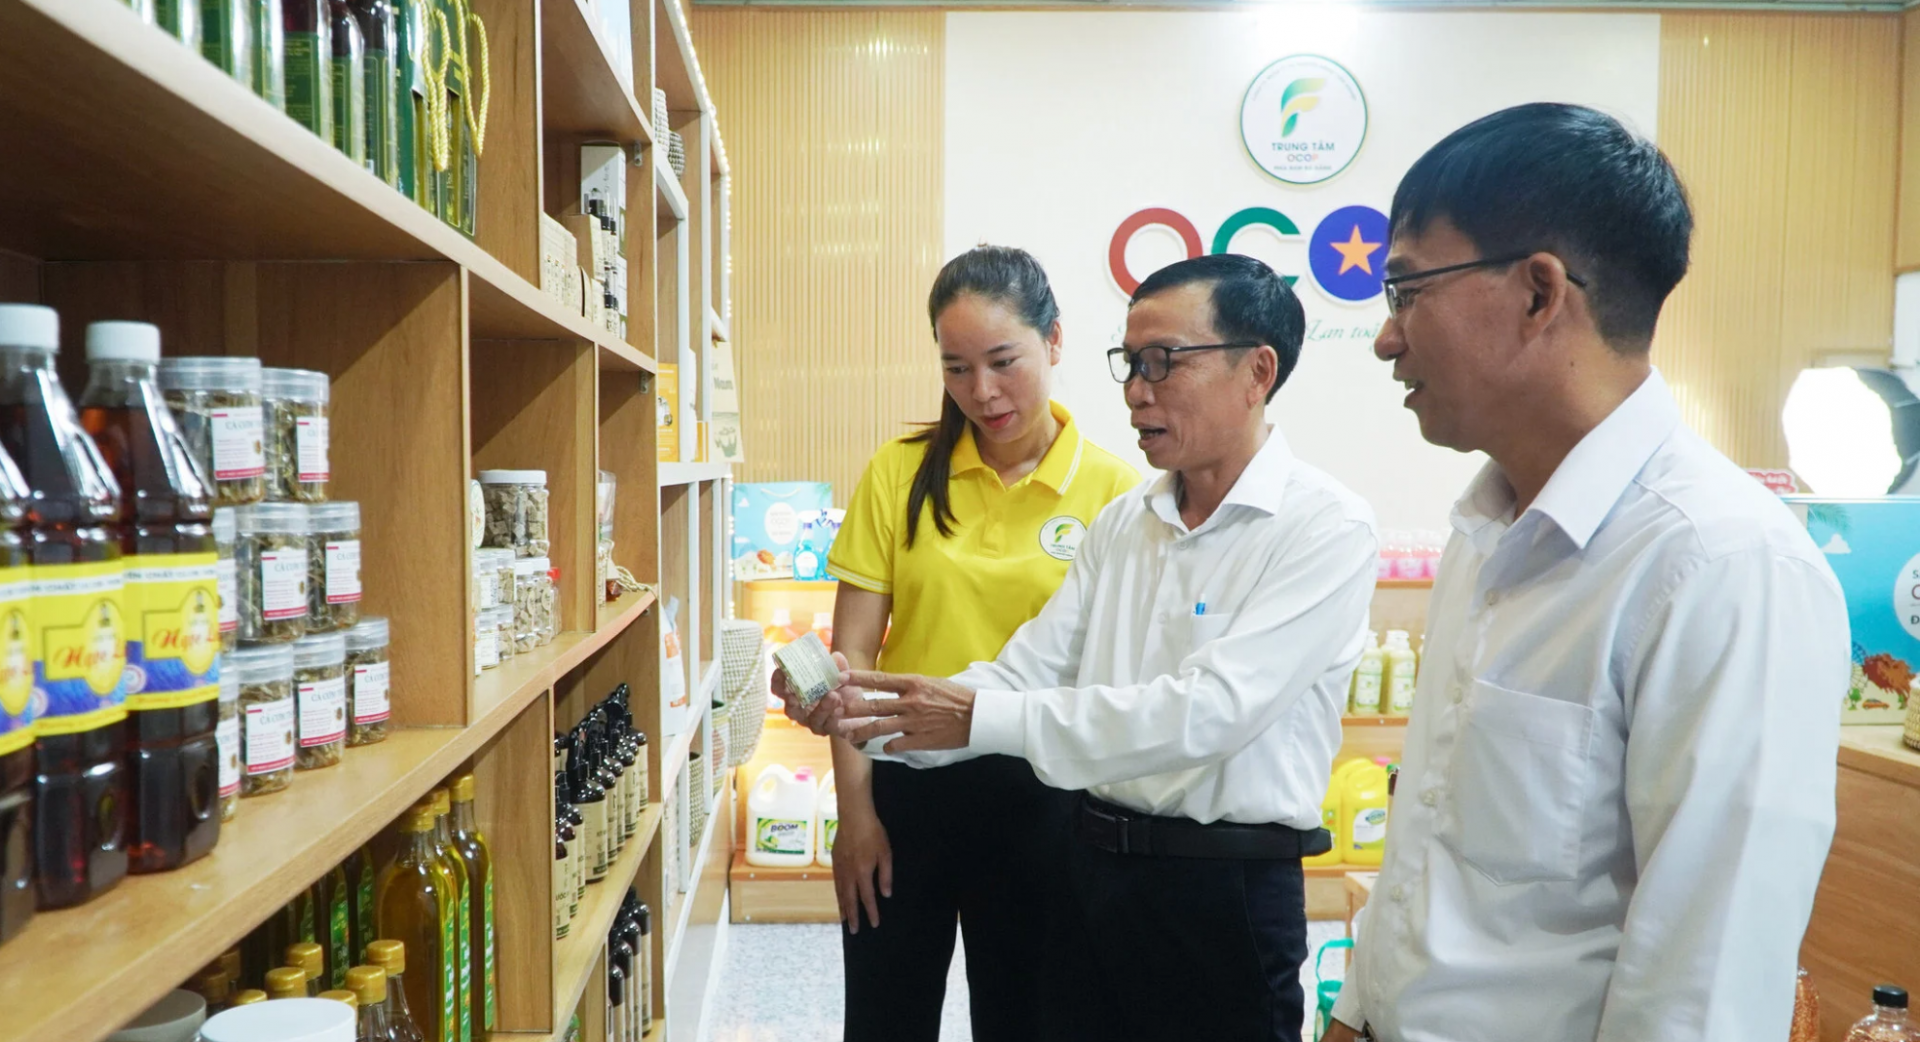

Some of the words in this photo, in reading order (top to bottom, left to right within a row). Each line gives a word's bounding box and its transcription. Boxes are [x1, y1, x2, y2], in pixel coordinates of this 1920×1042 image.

[1271, 142, 1308, 151] TRUNG
[1312, 139, 1335, 151] TÂM
[771, 823, 799, 833] BOOM
